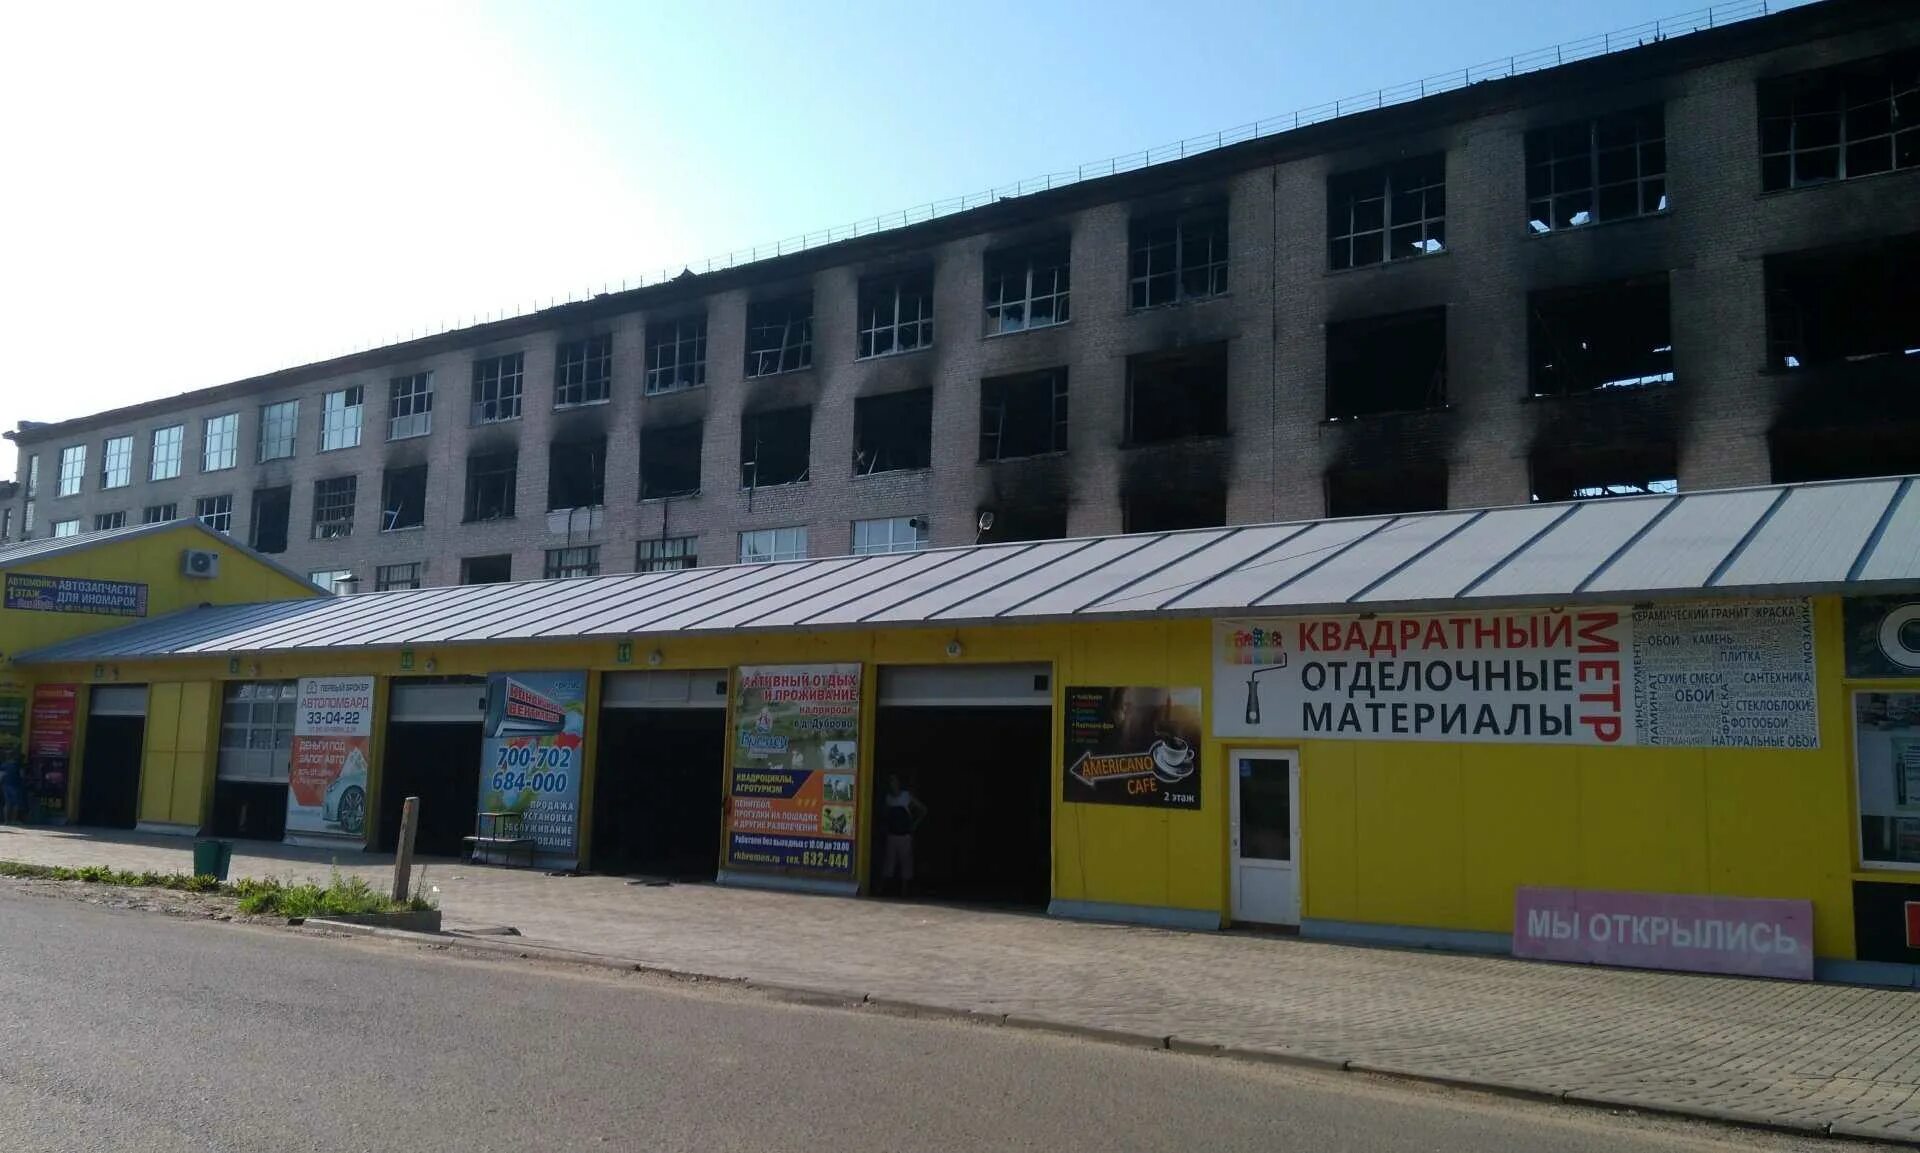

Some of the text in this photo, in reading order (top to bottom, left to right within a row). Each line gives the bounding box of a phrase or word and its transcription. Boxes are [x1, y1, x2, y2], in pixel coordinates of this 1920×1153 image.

[59, 580, 137, 595] АВТОЗАПЧАСТИ
[57, 591, 136, 607] ДЛЯ ИНОМАРОК
[1632, 607, 1748, 621] КЕРАМИЧЕСКИЙ ГРАНИТ
[1756, 606, 1795, 618] КРАСКА
[1299, 605, 1572, 658] КВАДРАТНЫЙ
[1648, 635, 1680, 646] ОБОИ
[1693, 633, 1735, 645] КАМЕНЬ
[1720, 651, 1761, 662] ПЛИТКА
[744, 673, 857, 688] АКТИВНЫЙ ОТДЫХ
[1301, 659, 1573, 699] ОТДЕЛОЧНЫЕ
[1577, 612, 1622, 743] МЕТР
[1657, 672, 1723, 684] СУХИЕ СМЕСИ
[1743, 672, 1811, 684] САНТЕХНИКА
[1632, 643, 1643, 729] ИНСТРУМЕНТ
[774, 689, 857, 701] ПРОЖИВАНИЕ
[1675, 688, 1714, 702] ОБОИ
[1648, 675, 1659, 745] ЛАМИНАТ
[1720, 683, 1730, 734] ФРЕСКА
[1736, 700, 1810, 711] СТЕКЛОБЛОКИ
[307, 711, 360, 724] 33-04-22
[1302, 702, 1572, 736] МАТЕРИАЛЫ
[1731, 717, 1788, 729] ФОТООБОИ
[1712, 735, 1817, 747] НАТУРАЛЬНЫЕ ОБОИ
[498, 748, 571, 768] 700-702
[1082, 755, 1153, 777] AMERICANO
[492, 771, 567, 792] 684-000
[736, 784, 782, 793] АГРОТУРИЗМ
[1127, 777, 1158, 794] CAFE
[1163, 792, 1195, 803] 2 этаж
[530, 800, 574, 811] ПРОДАЖА
[523, 812, 573, 823] УСТАНОВКА
[1528, 909, 1798, 956] МЫ ОТКРЫЛИСЬ
